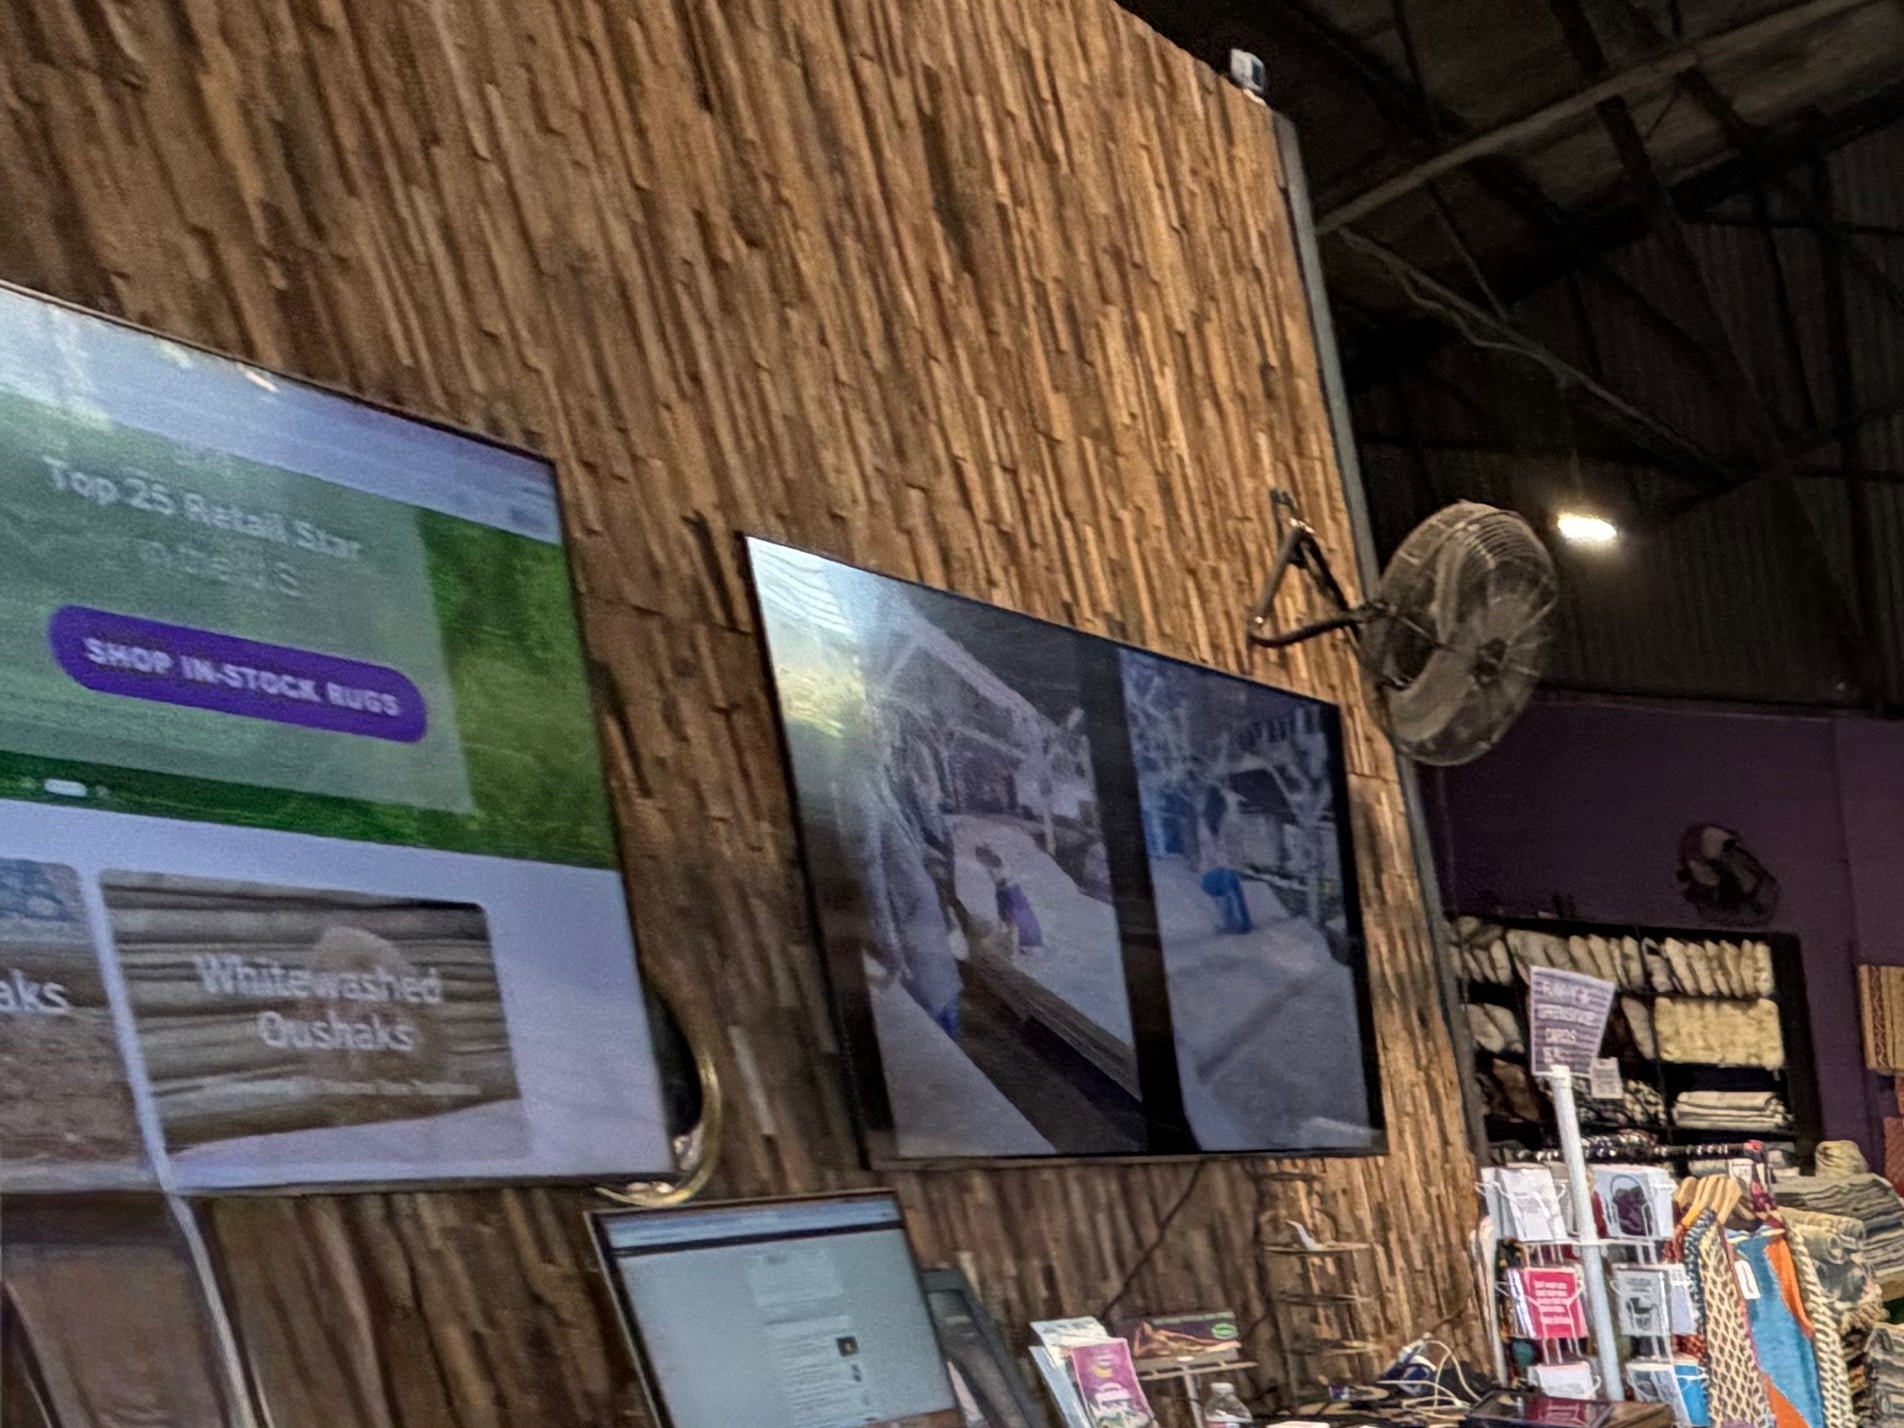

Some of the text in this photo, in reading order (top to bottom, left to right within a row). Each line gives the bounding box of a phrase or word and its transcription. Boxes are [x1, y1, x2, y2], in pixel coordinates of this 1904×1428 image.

[121, 476, 177, 517] 25
[82, 636, 401, 718] SHOP IN-STOCK RUGS
[193, 953, 443, 1004] Whitewashed
[255, 1009, 417, 1053] Oushaks
